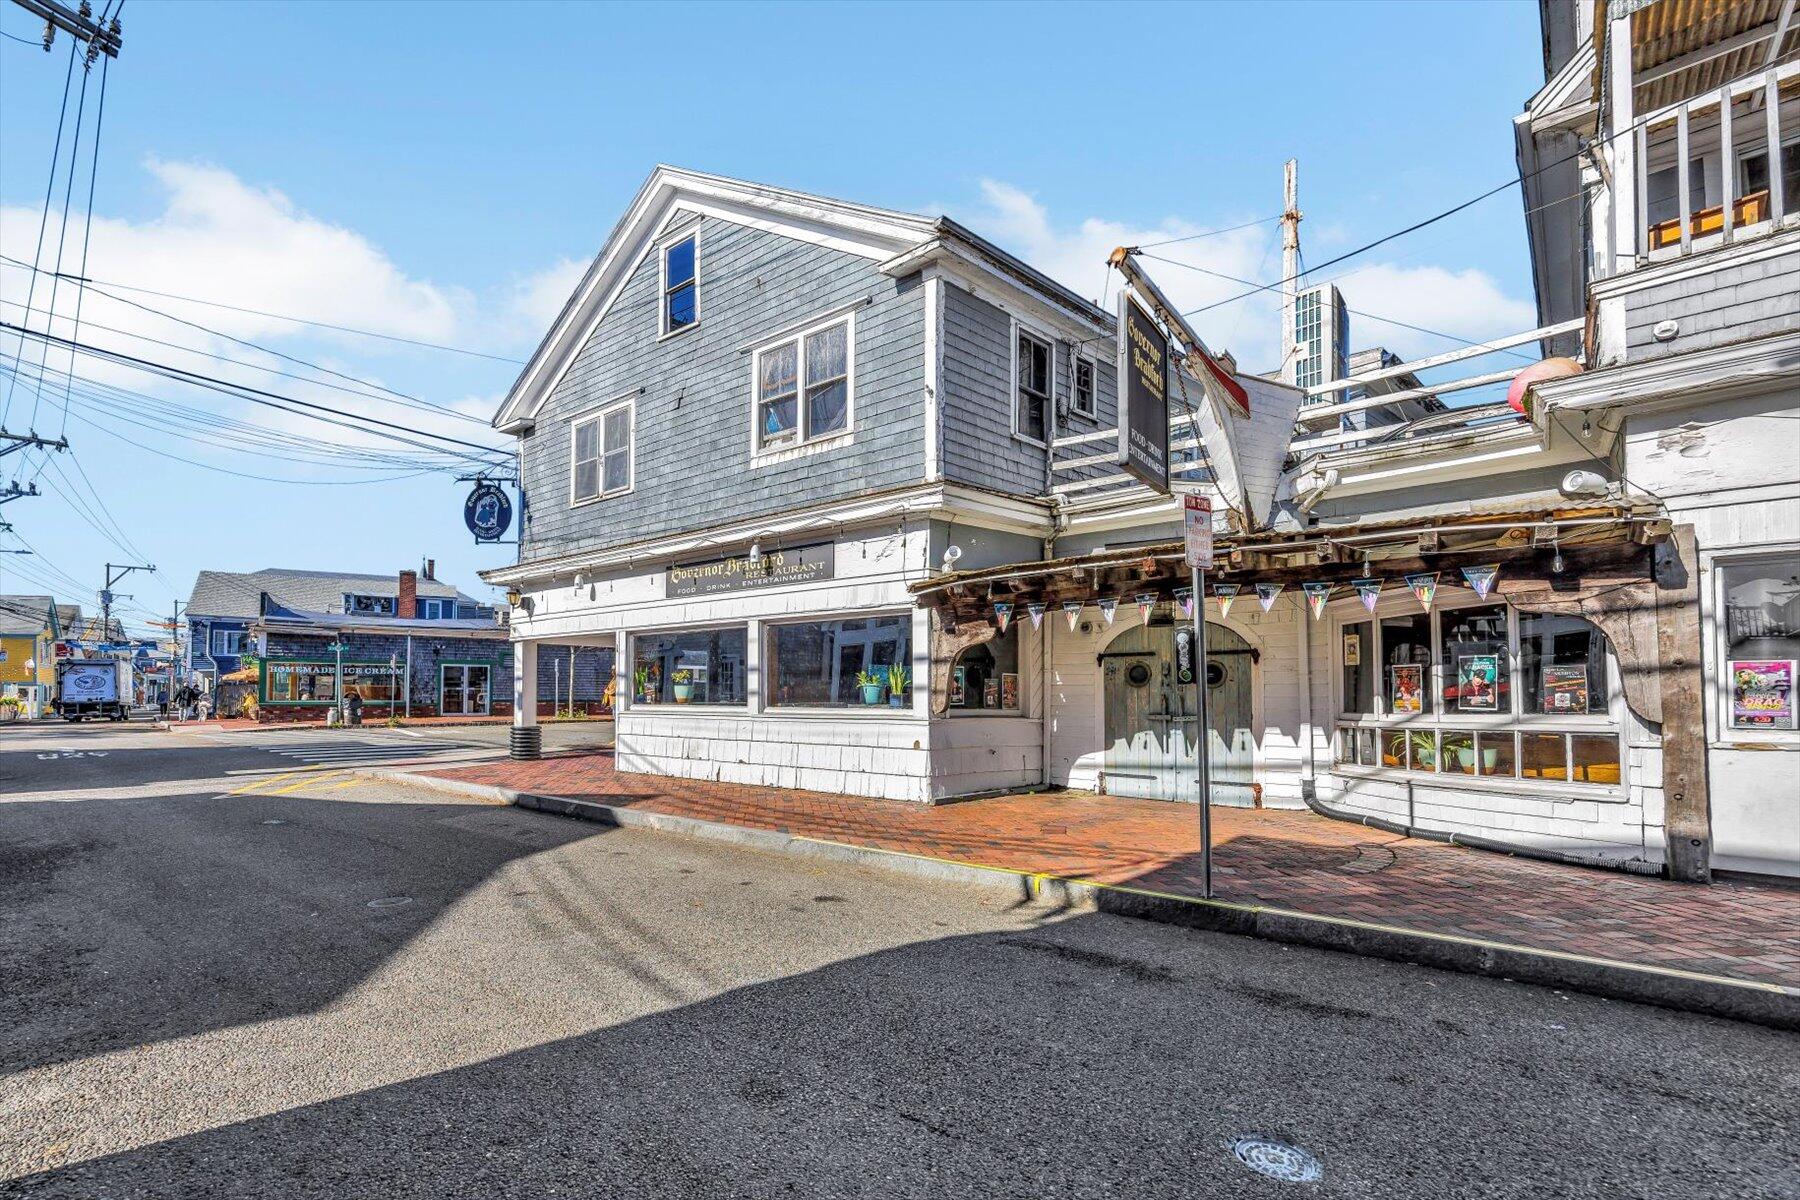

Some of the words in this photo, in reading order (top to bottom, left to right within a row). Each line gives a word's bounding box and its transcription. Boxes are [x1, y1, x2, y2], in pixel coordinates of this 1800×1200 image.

[1131, 427, 1146, 447] FOOD
[1194, 515, 1204, 526] NO
[671, 564, 723, 584] Governor
[677, 587, 697, 595] FOOD
[706, 582, 731, 591] DRINK
[742, 571, 816, 587] ENTERTAINMENT
[270, 666, 336, 674] HOMEMADE
[344, 667, 363, 675] ICE
[364, 667, 404, 675] CREAM
[1742, 697, 1785, 706] DRAG
